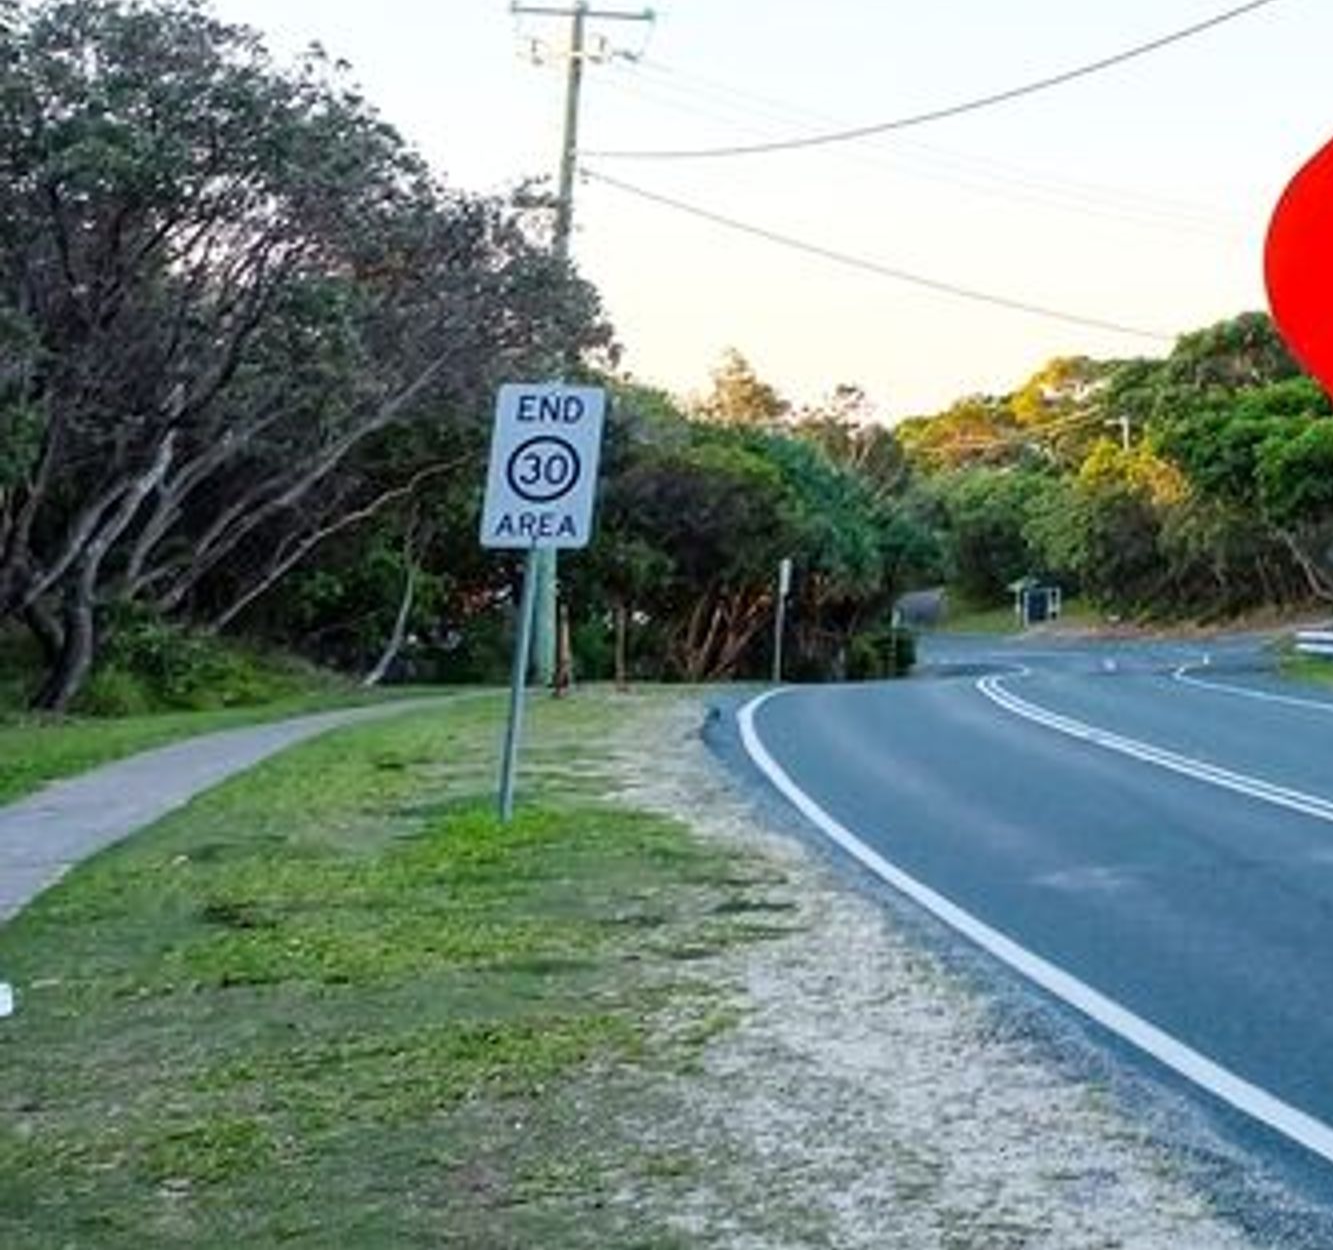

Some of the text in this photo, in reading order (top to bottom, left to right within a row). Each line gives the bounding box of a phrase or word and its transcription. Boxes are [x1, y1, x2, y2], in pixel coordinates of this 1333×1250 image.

[516, 395, 585, 424] END
[519, 452, 569, 485] 30
[495, 512, 577, 537] AREA
